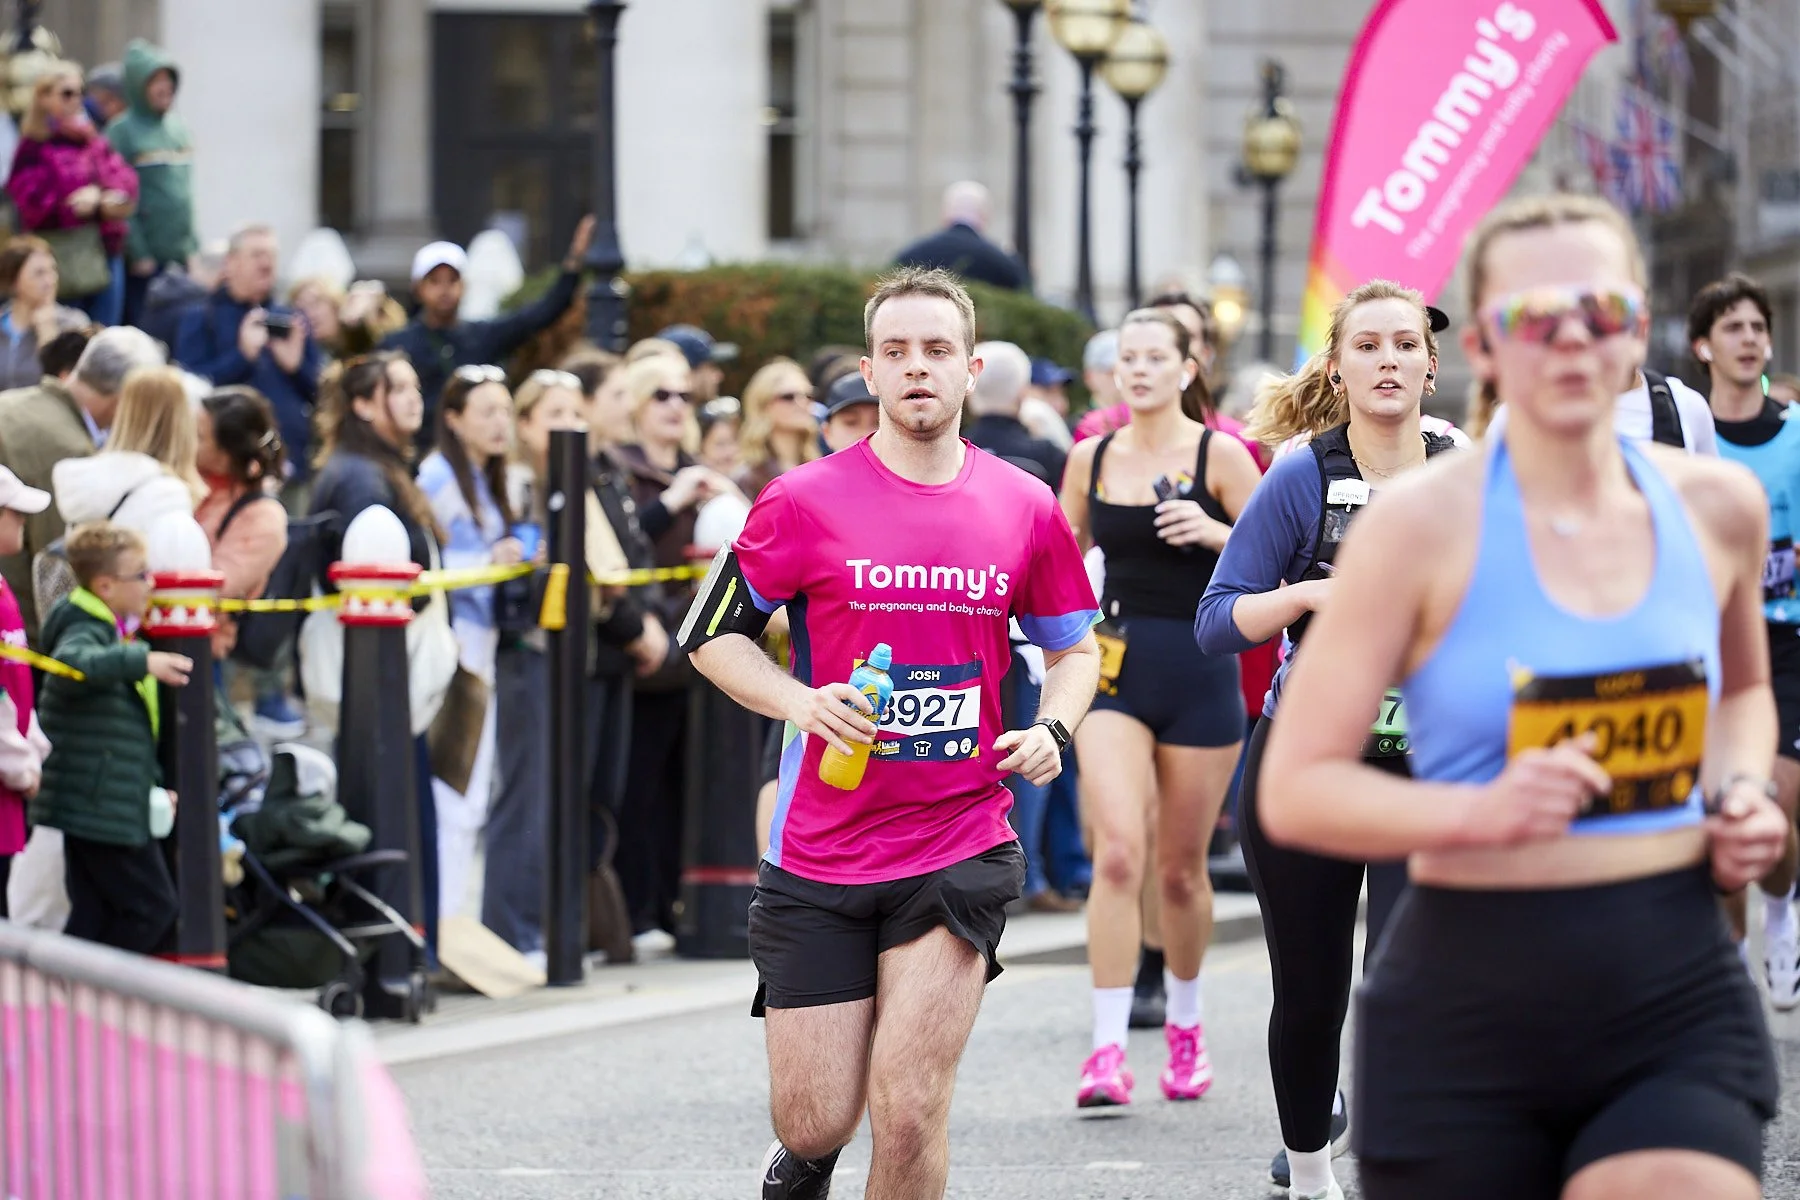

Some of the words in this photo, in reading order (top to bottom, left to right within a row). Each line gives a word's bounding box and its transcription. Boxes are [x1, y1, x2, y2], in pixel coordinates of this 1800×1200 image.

[1351, 1, 1536, 236] Tommy's
[1332, 491, 1363, 501] UPFRONT
[845, 558, 1010, 601] Tommy's
[848, 601, 867, 611] The
[868, 602, 924, 613] pregnancy
[925, 601, 947, 612] and
[948, 602, 975, 616] baby
[976, 605, 1003, 618] charity
[907, 670, 941, 681] JOSH
